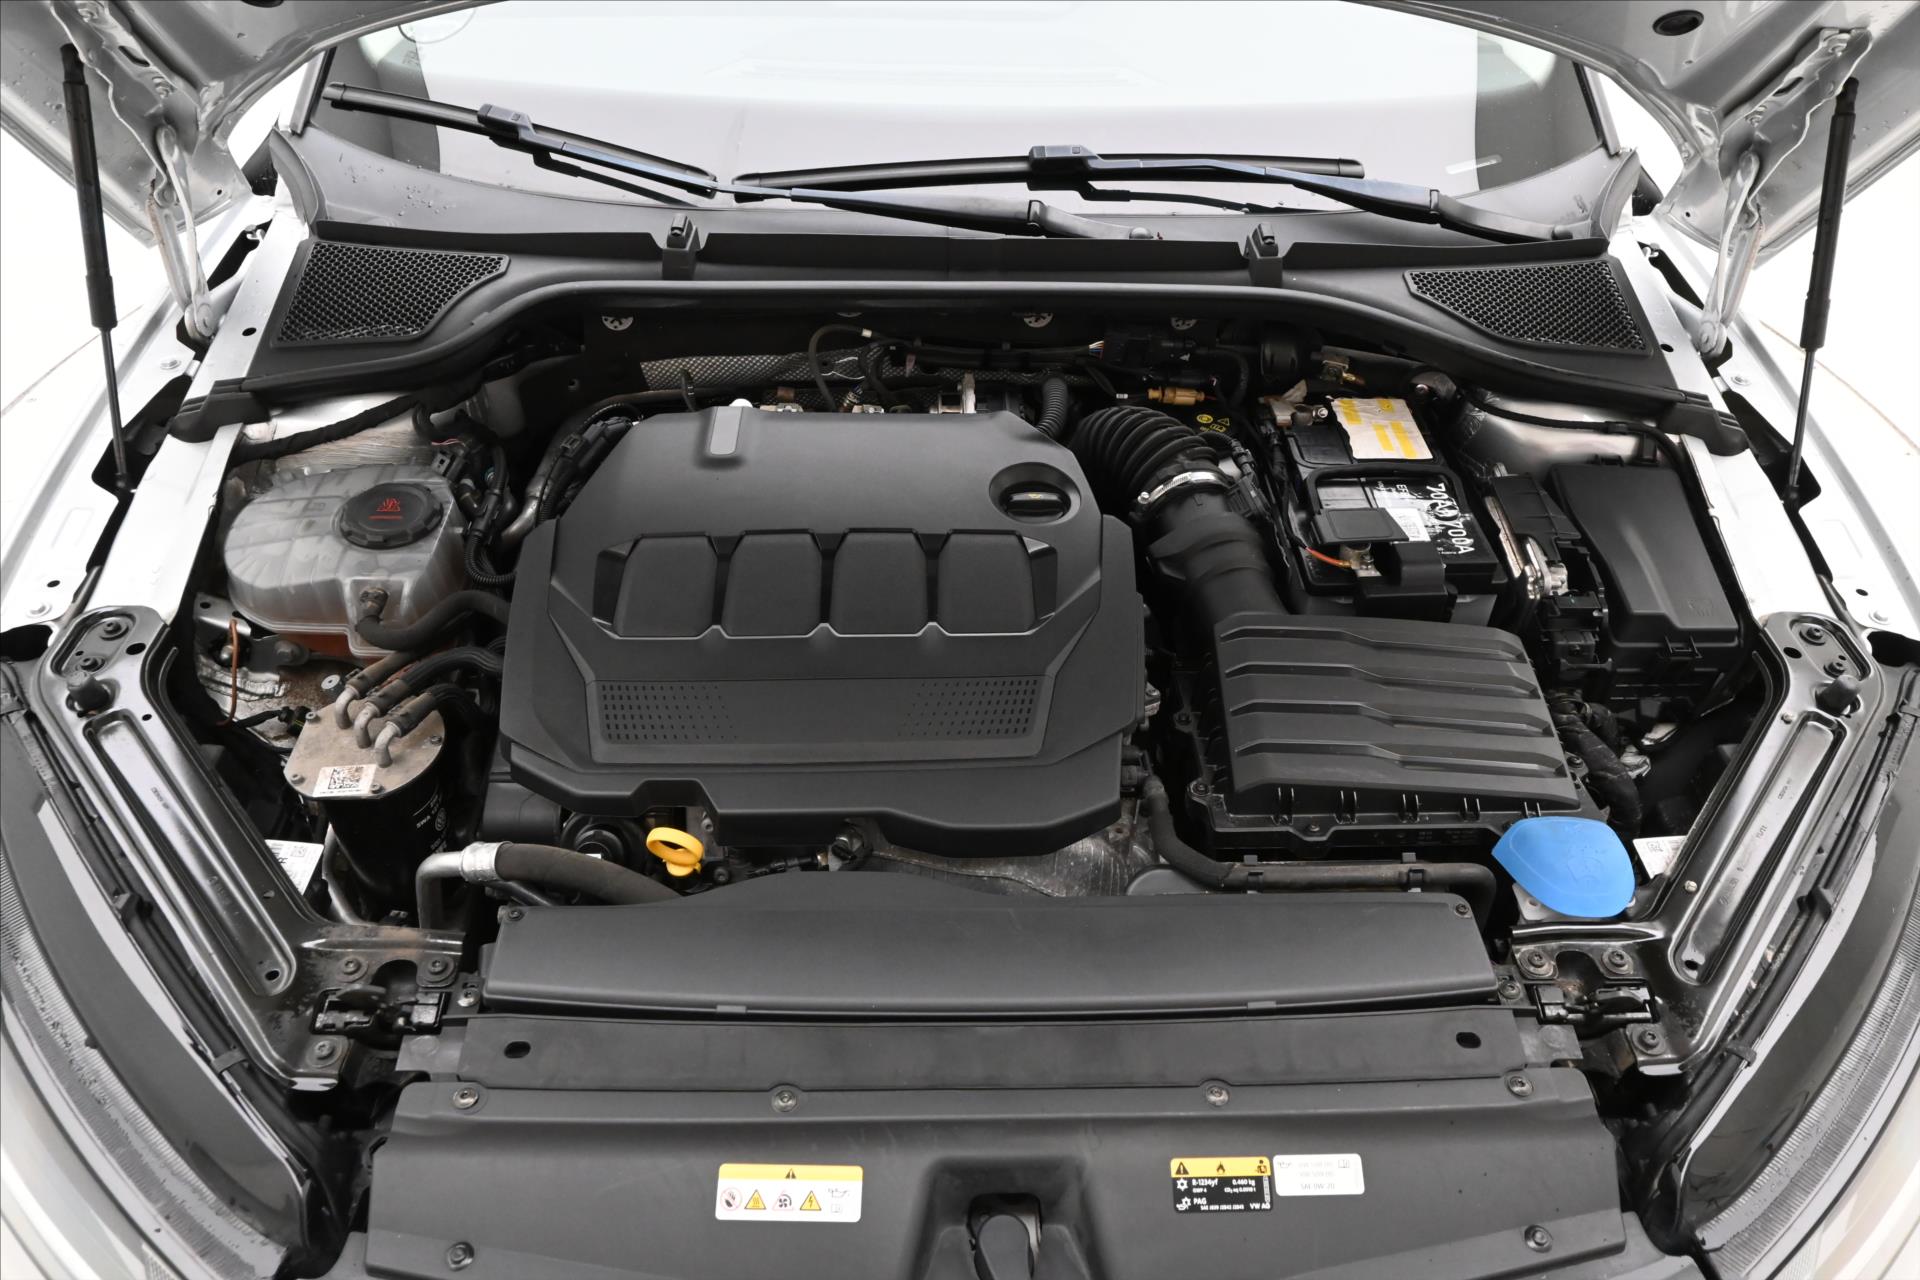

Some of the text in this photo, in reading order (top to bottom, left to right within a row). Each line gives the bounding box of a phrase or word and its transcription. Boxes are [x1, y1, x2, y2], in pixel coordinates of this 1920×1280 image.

[1439, 521, 1475, 554] 700A
[1193, 1197, 1207, 1205] PAG
[1249, 1202, 1260, 1210] VW
